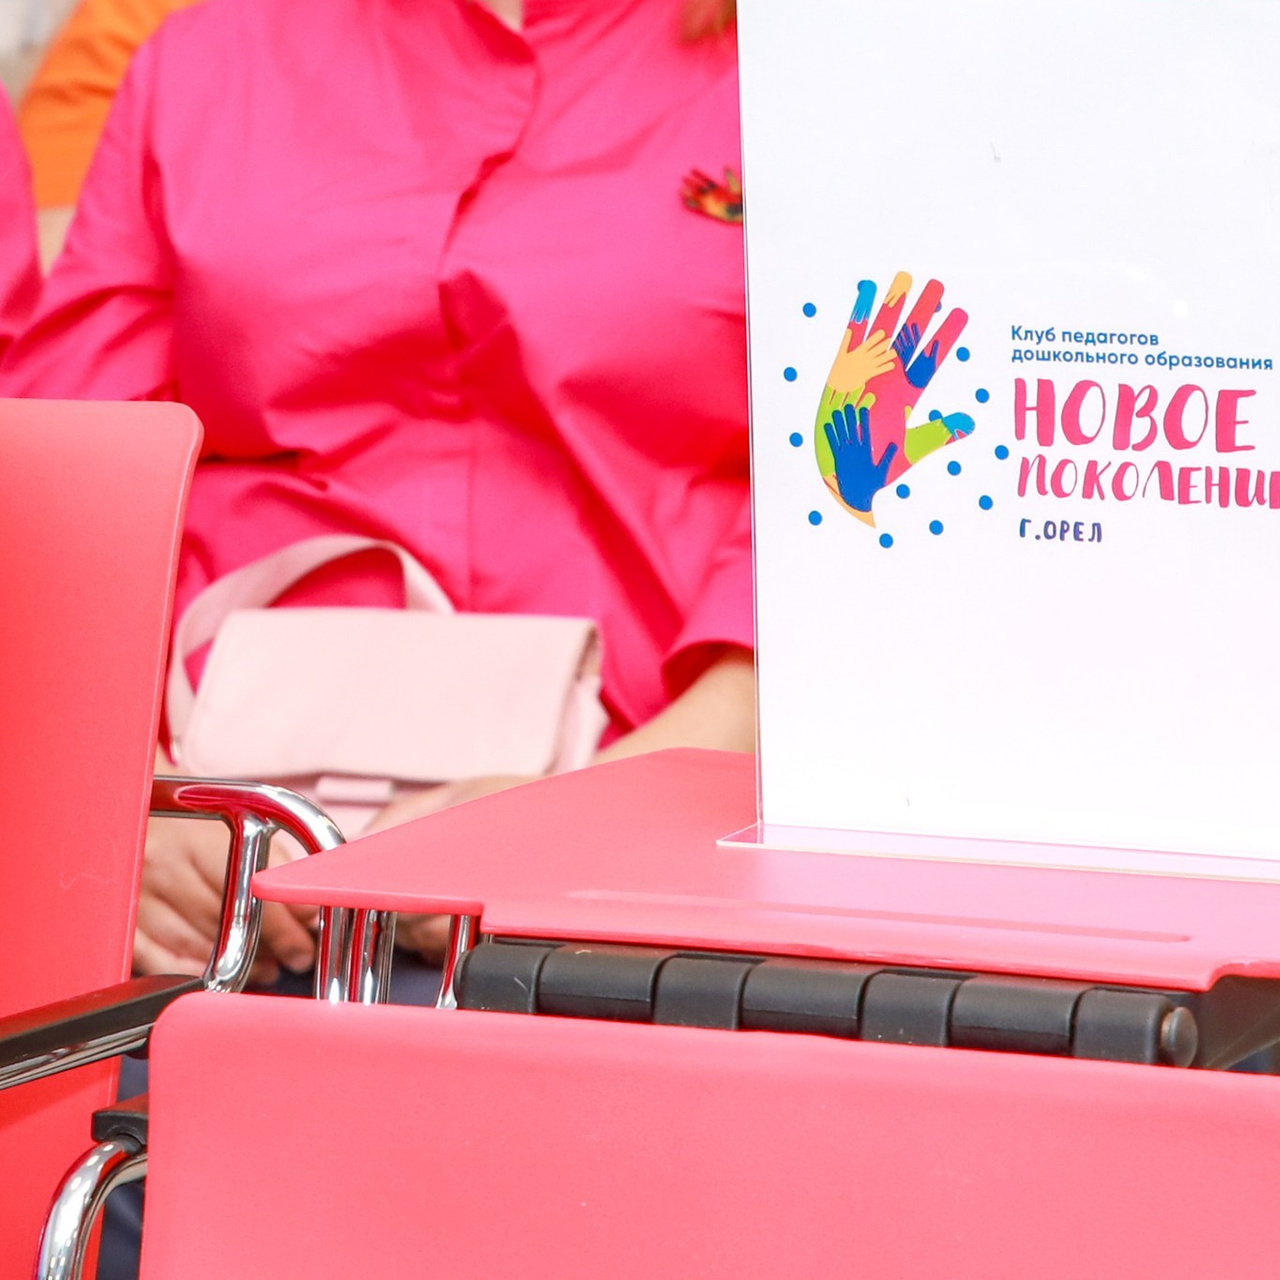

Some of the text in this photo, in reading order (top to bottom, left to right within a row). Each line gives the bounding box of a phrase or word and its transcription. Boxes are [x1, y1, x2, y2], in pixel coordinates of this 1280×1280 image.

[1011, 326, 1159, 346] Клуб педагогов
[1011, 348, 1273, 370] дошкольного образования
[1014, 377, 1257, 453] НОВОЕ
